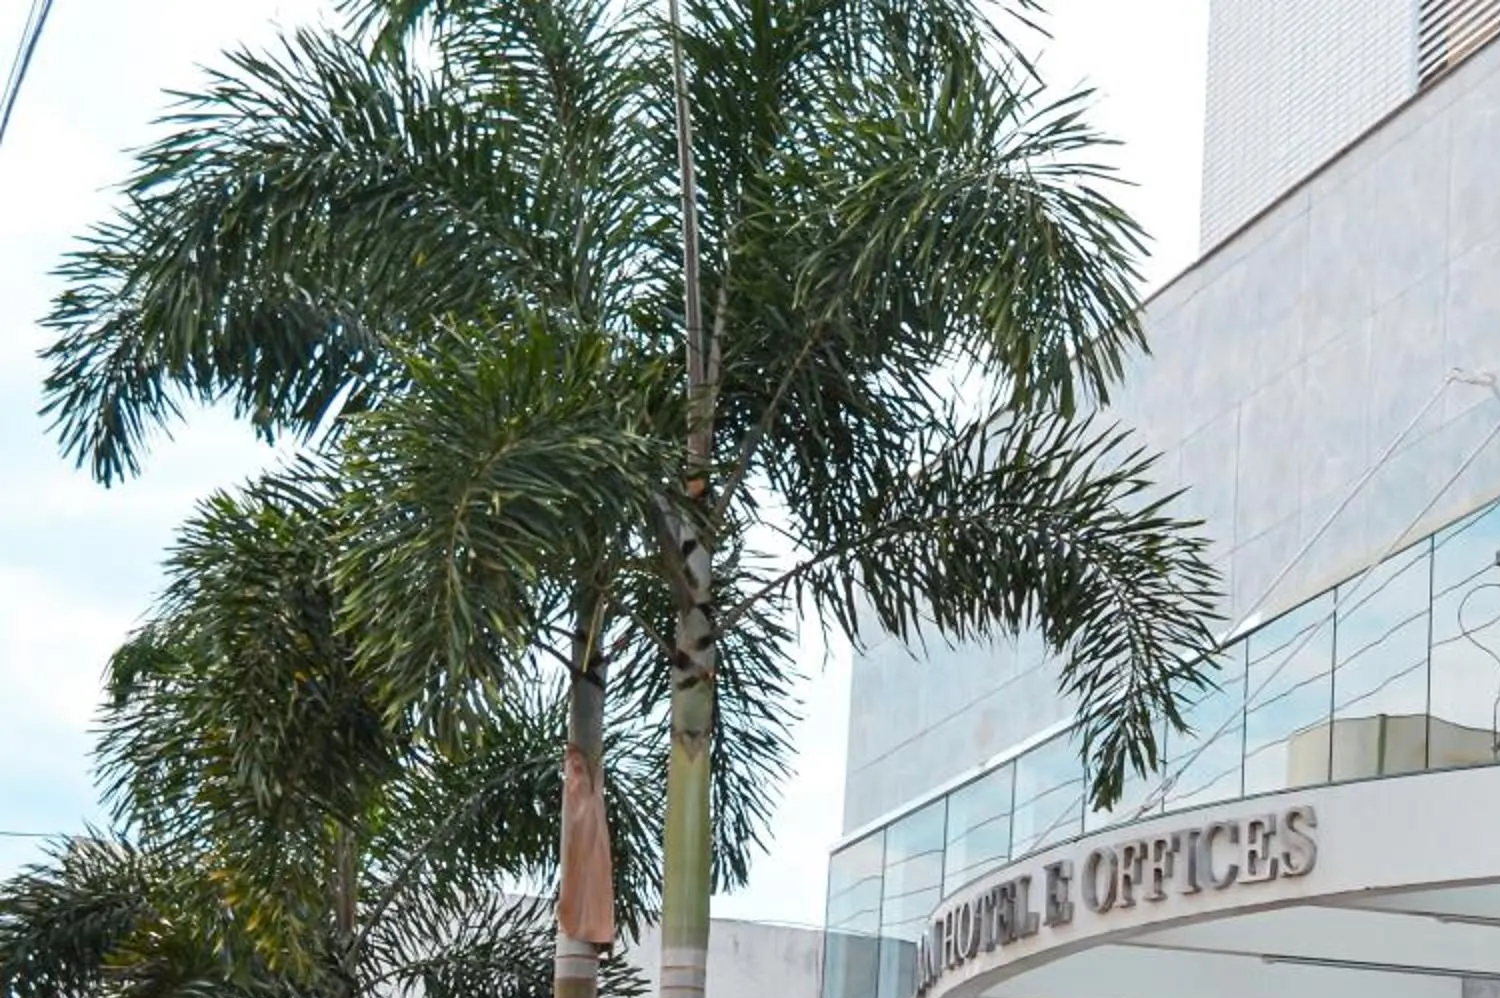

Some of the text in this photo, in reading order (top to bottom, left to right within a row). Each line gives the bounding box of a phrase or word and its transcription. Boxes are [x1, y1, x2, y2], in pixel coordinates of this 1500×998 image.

[942, 874, 1040, 971] HOTEL
[1043, 859, 1075, 929] E
[1082, 804, 1318, 914] OFFICES
